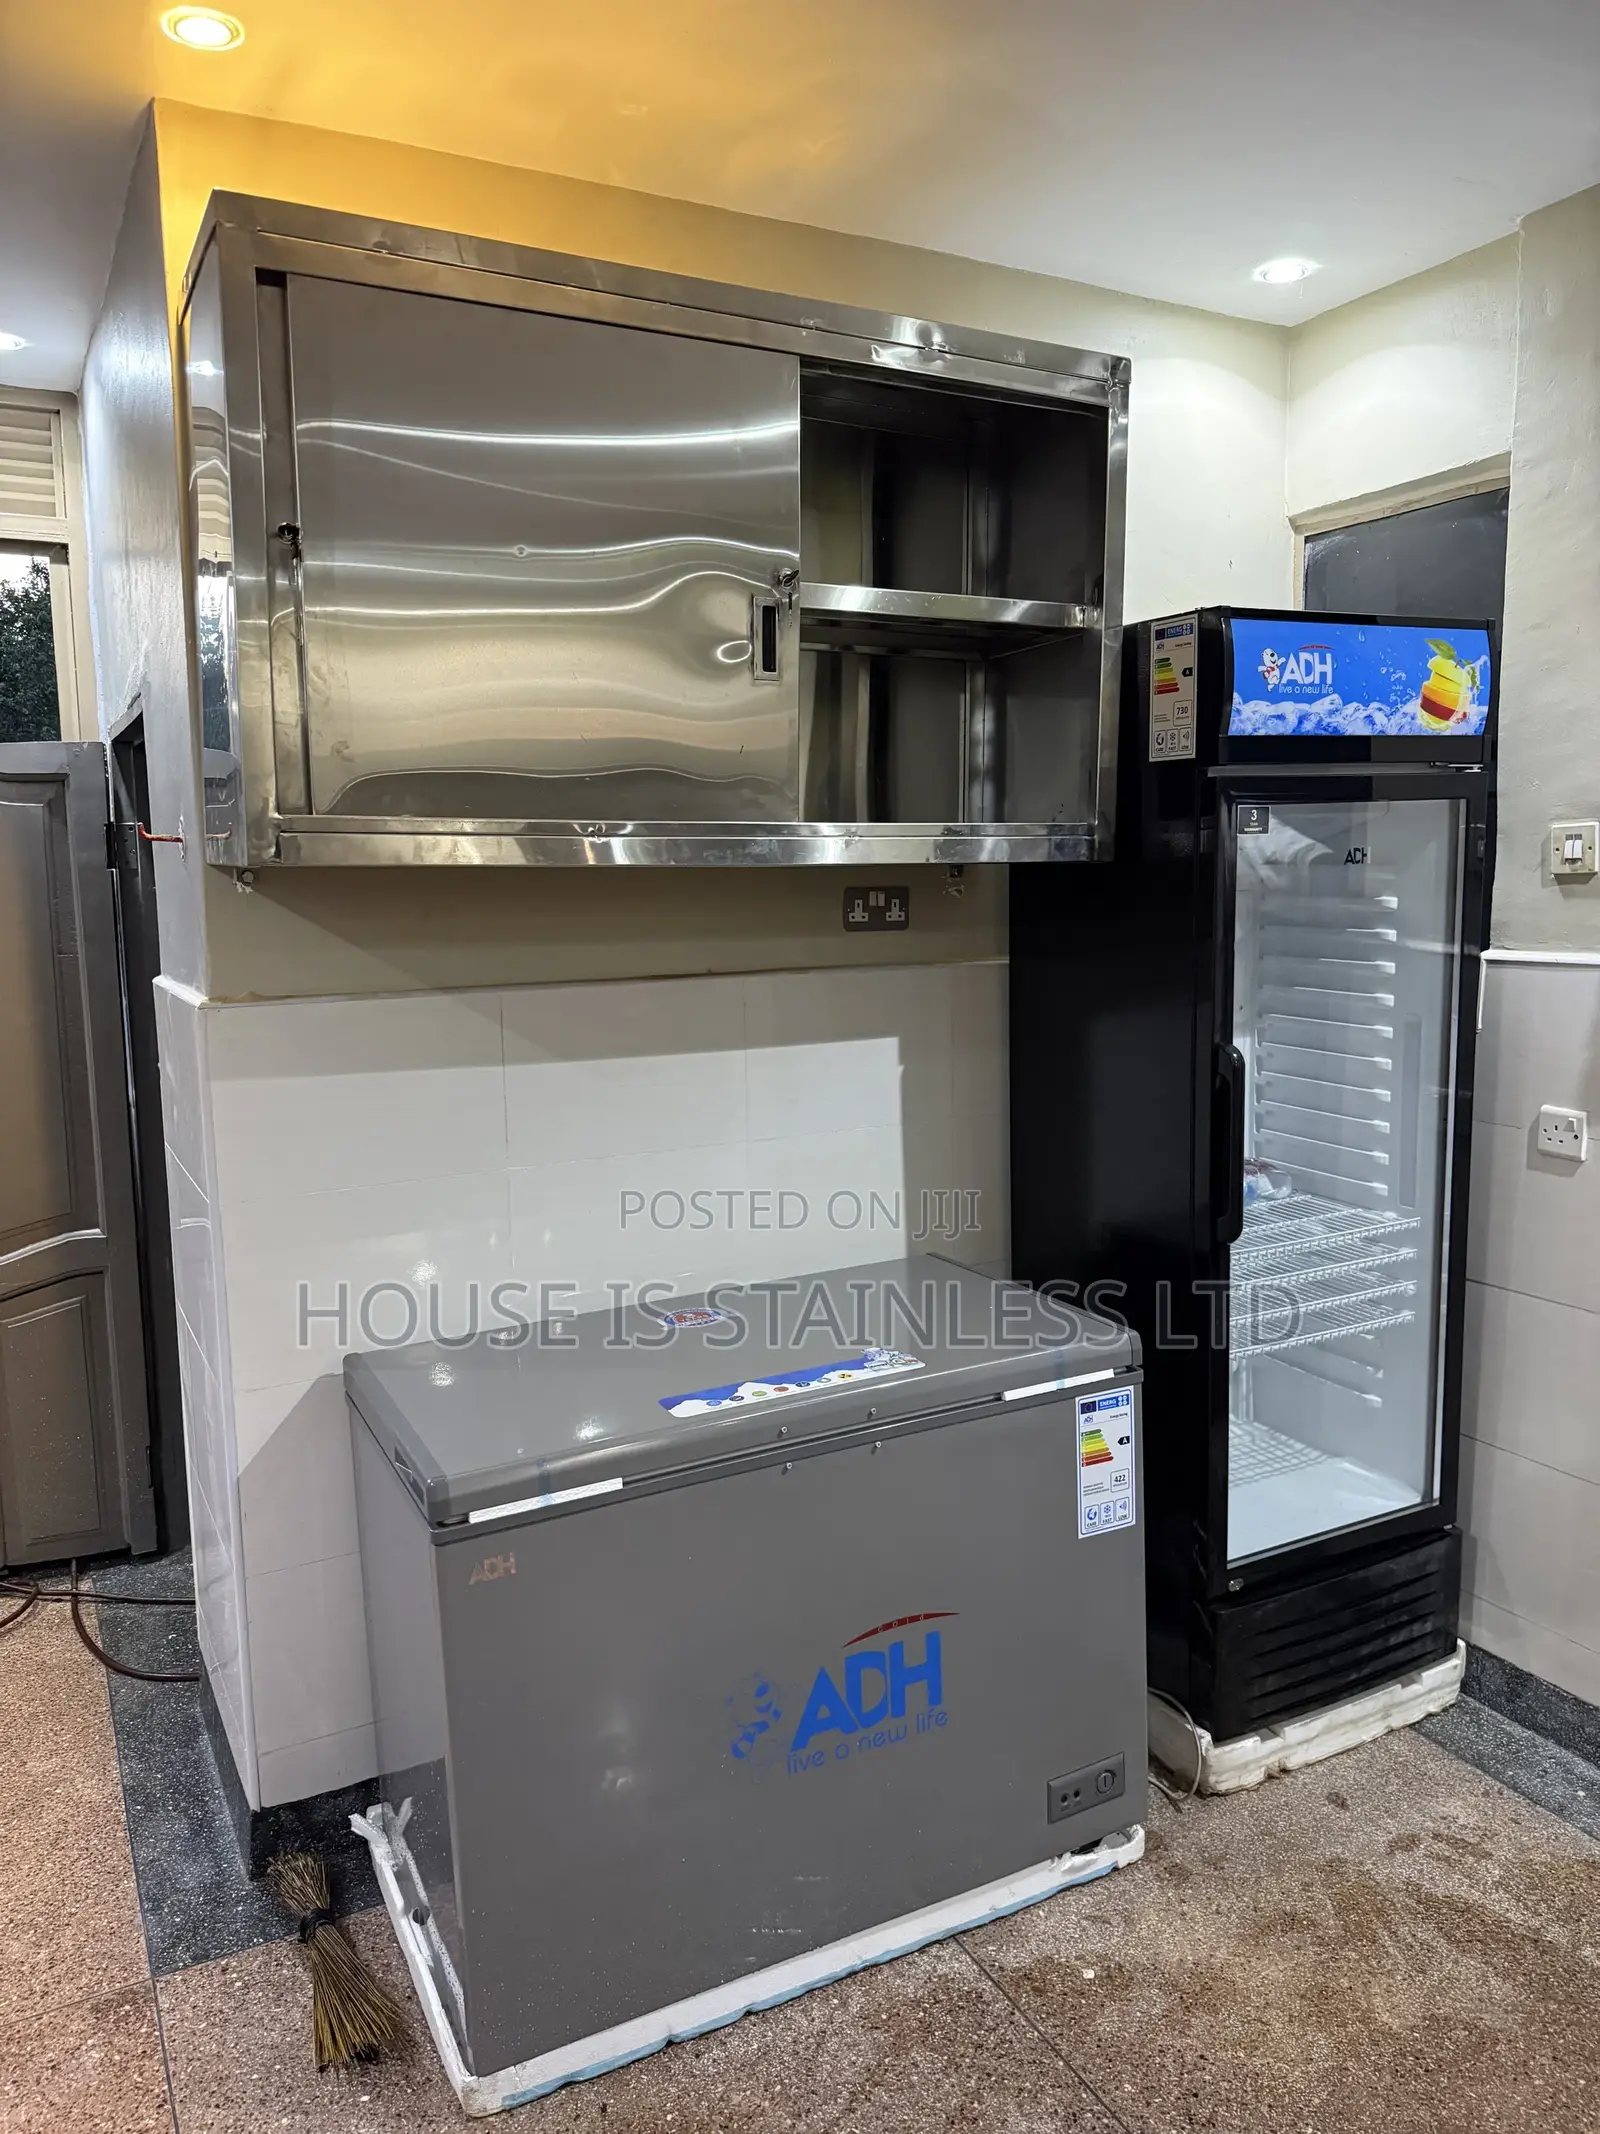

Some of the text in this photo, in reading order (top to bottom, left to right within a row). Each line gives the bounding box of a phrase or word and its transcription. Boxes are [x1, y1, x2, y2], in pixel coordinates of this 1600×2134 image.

[1281, 652, 1333, 684] ADH
[1278, 684, 1293, 694] live
[1302, 685, 1320, 694] new
[1321, 683, 1334, 694] life
[1176, 706, 1189, 715] 730
[1250, 809, 1257, 821] 3
[1113, 1474, 1126, 1483] 422
[468, 1551, 517, 1586] ADH
[790, 1630, 943, 1752] ADH
[786, 1750, 825, 1777] live
[858, 1724, 908, 1753] new
[916, 1708, 948, 1735] life
